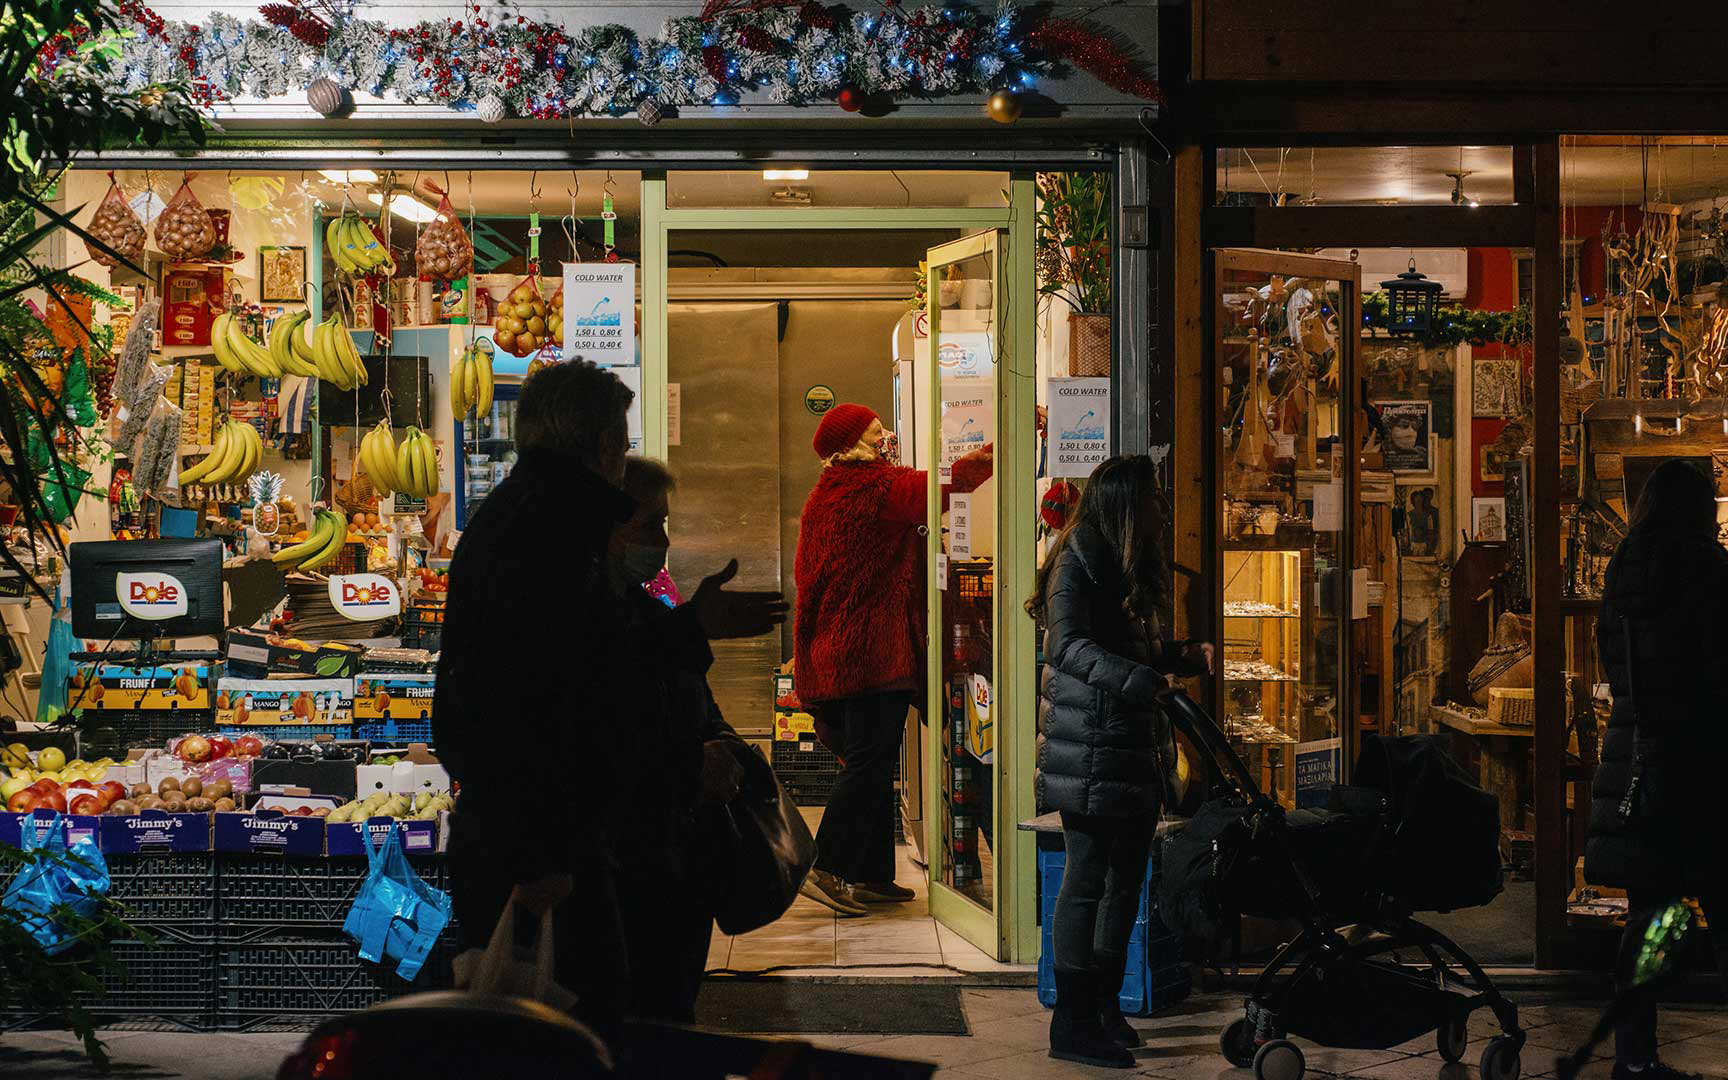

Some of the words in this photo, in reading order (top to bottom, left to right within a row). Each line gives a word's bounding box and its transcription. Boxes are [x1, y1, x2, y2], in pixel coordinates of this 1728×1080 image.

[576, 329, 590, 337] 1,50
[600, 329, 616, 337] 0,80
[574, 341, 590, 349] 0,50
[600, 341, 616, 349] 0,40
[1060, 442, 1075, 451] 1,50
[1084, 442, 1100, 451] 0,80
[1058, 454, 1075, 463] 0,50
[1084, 454, 1100, 463] 0,40
[130, 581, 178, 600] Dole
[342, 582, 390, 602] Dole
[406, 688, 434, 698] FRUN
[976, 682, 988, 704] Dole
[126, 817, 182, 830] Jimmy's
[241, 818, 298, 832] Jimmy's
